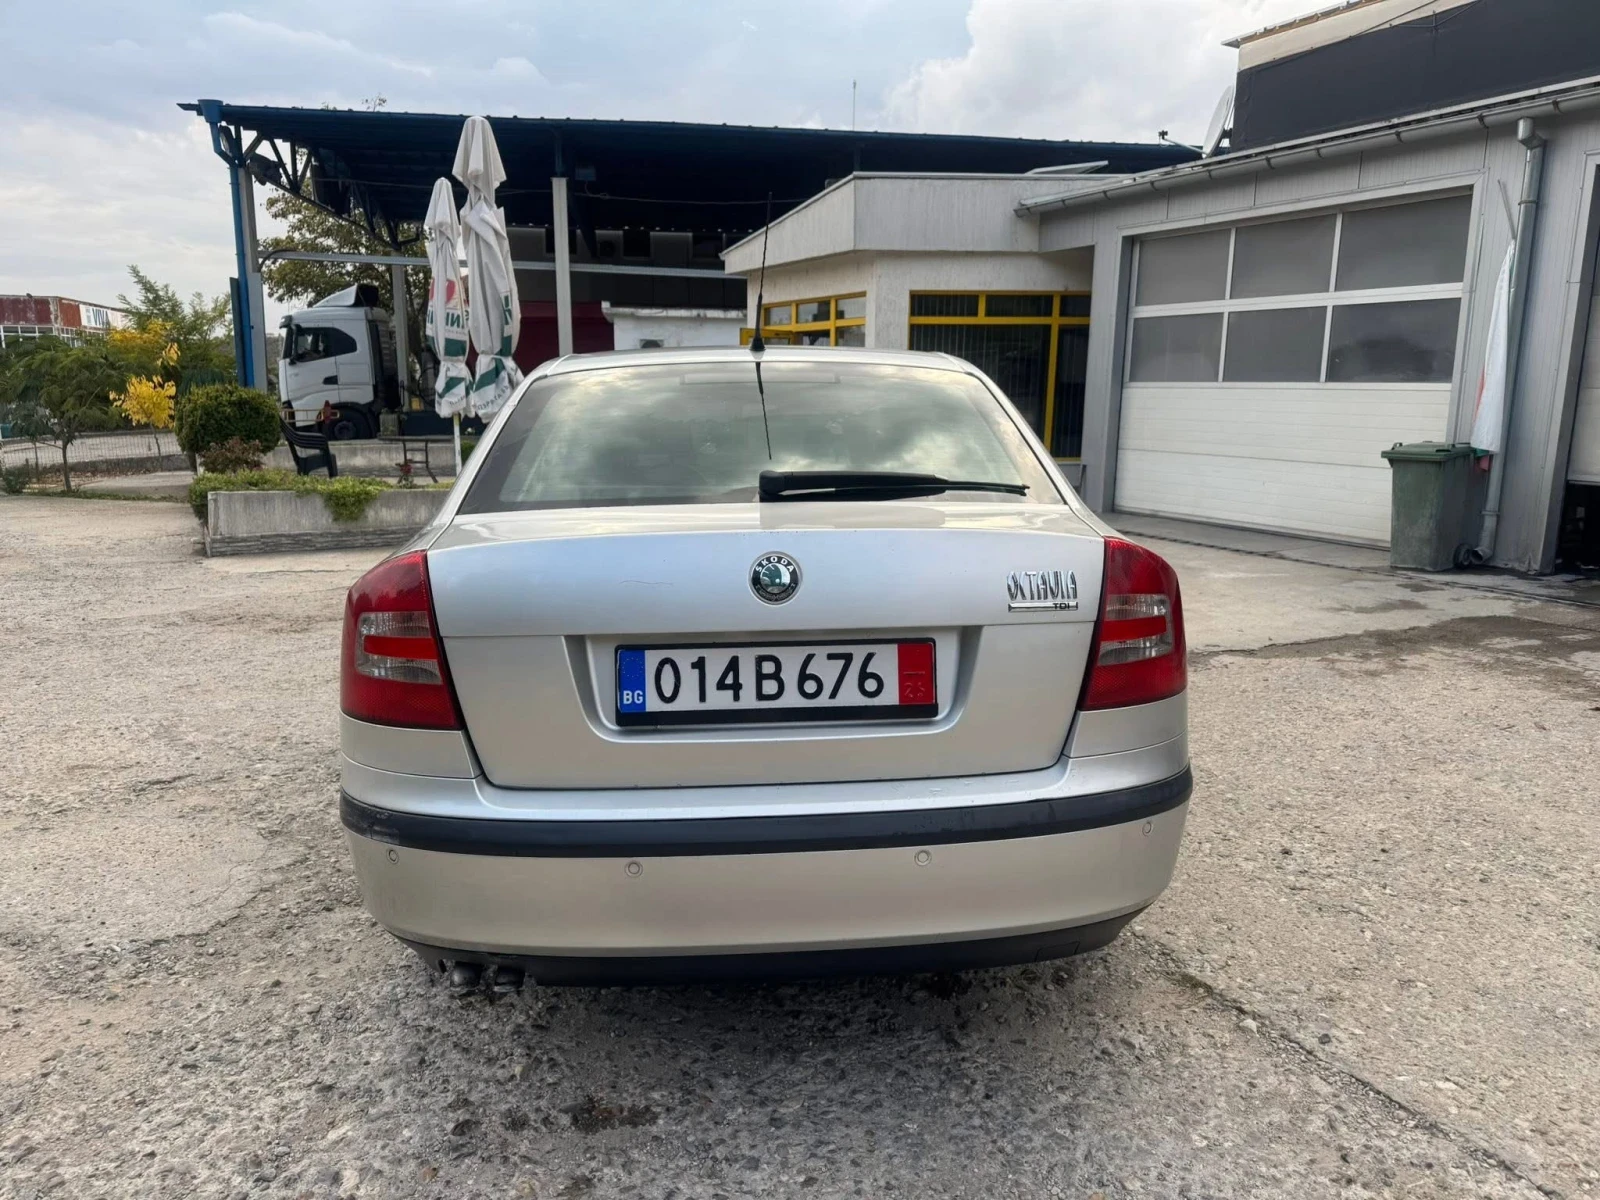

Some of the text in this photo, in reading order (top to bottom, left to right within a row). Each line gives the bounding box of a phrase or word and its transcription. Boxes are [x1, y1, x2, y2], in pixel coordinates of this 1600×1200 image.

[1006, 570, 1078, 600] OCTAVIA
[1052, 602, 1071, 610] TDI
[623, 690, 644, 705] BG
